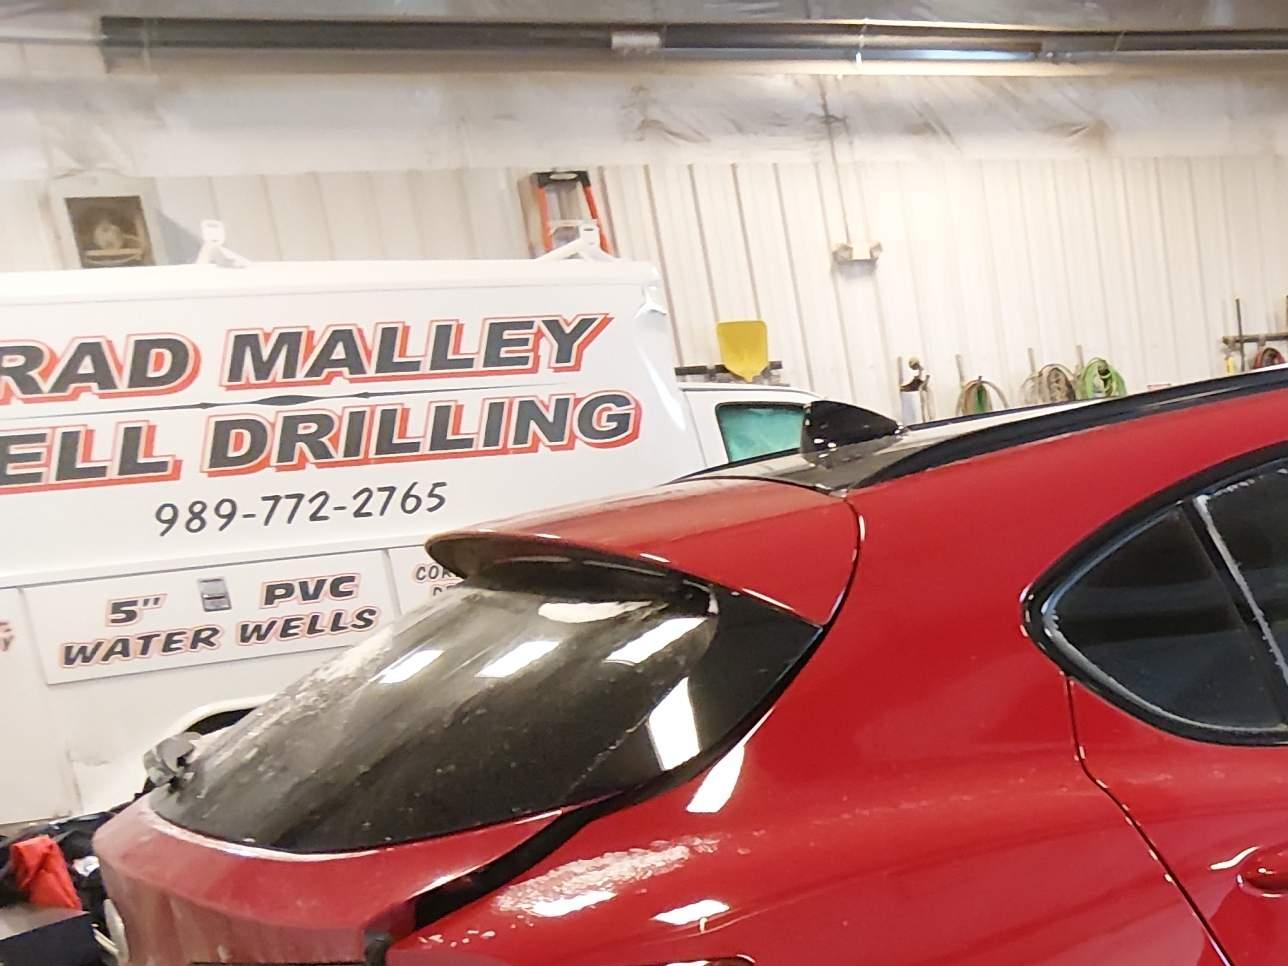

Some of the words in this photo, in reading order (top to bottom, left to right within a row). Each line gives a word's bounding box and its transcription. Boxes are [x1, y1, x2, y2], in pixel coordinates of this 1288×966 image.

[218, 313, 614, 390] MALLEY
[200, 389, 641, 477] DRILLING
[154, 481, 448, 537] 989-772-2765
[105, 593, 167, 626] 5"
[260, 573, 361, 609] PVC
[60, 624, 223, 667] WATER
[237, 607, 382, 645] WELLS
